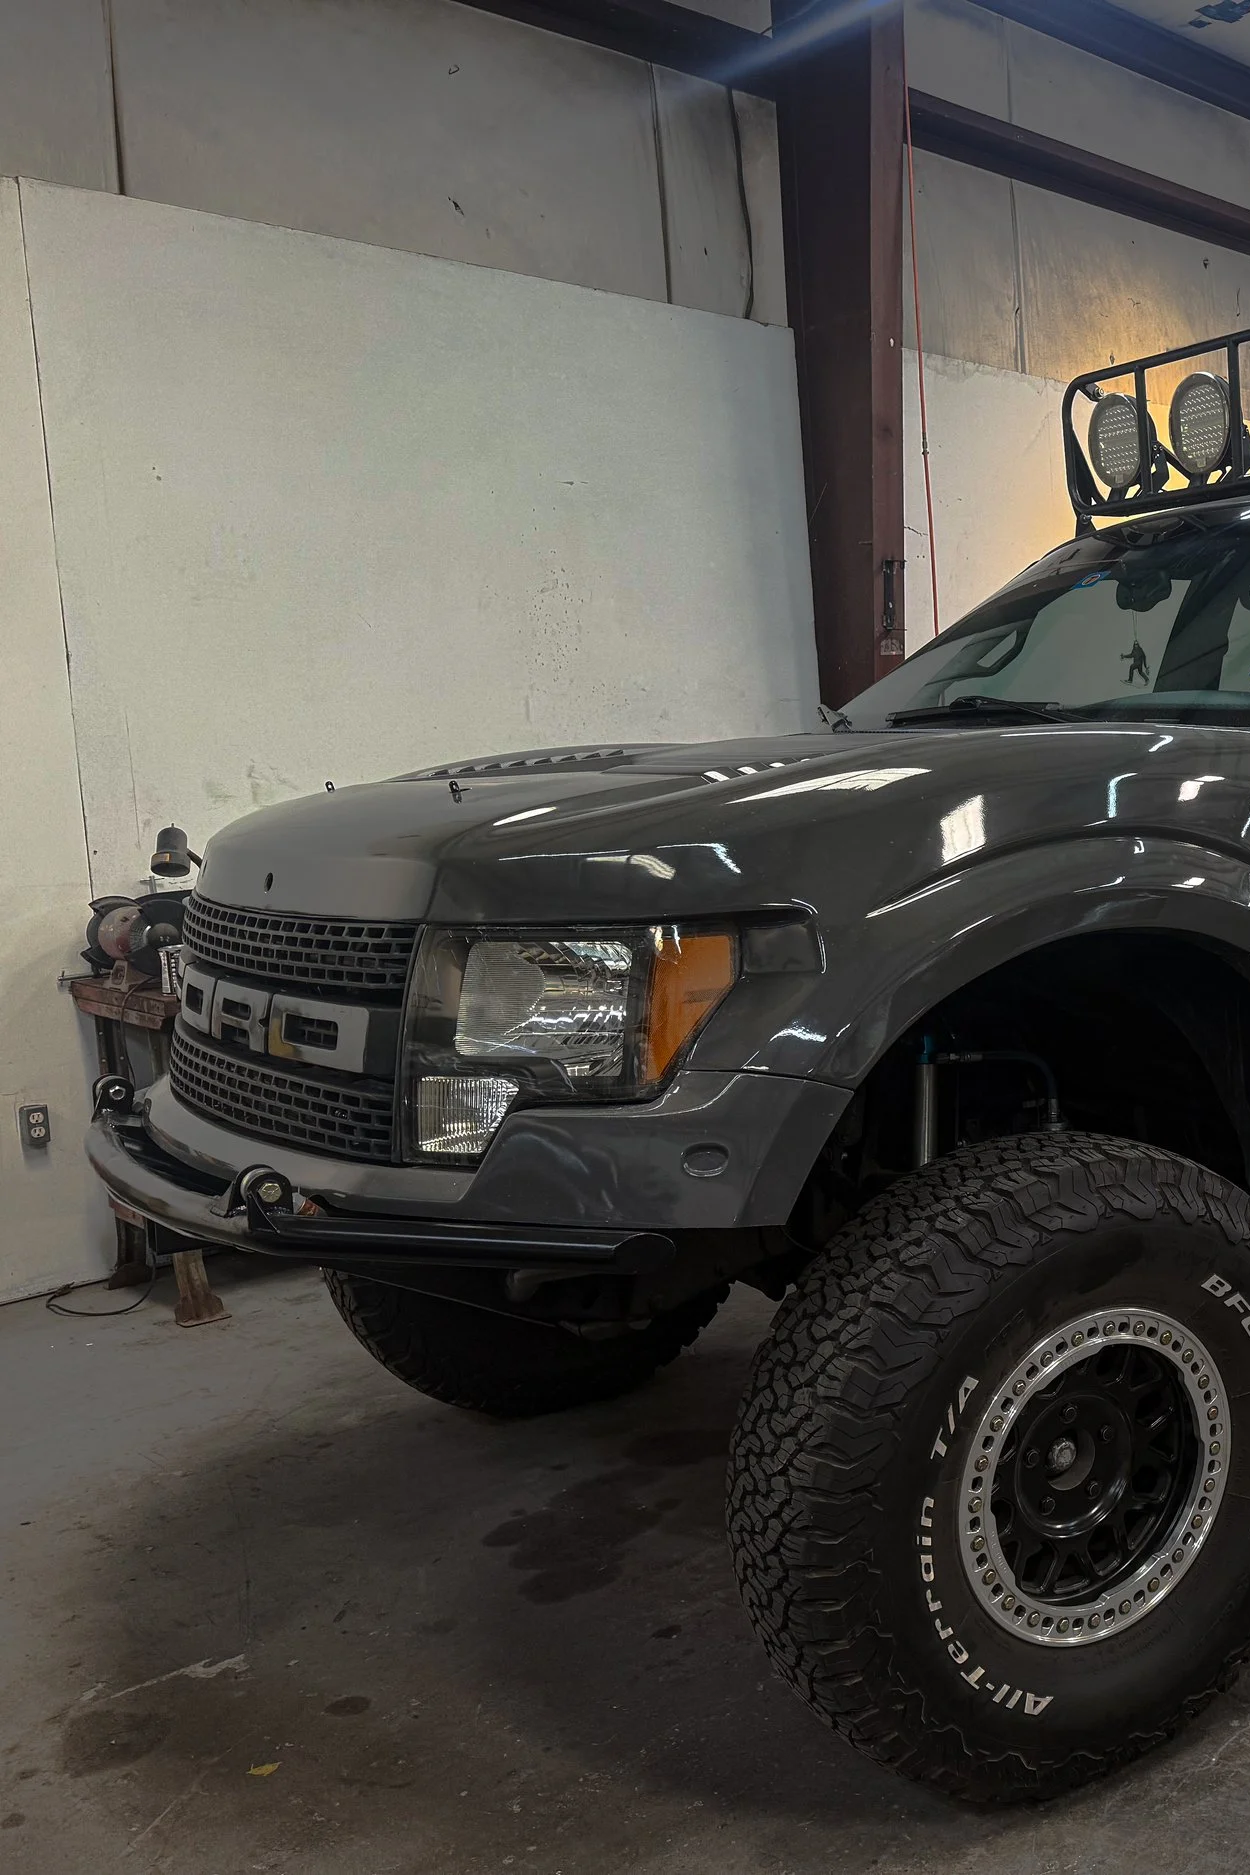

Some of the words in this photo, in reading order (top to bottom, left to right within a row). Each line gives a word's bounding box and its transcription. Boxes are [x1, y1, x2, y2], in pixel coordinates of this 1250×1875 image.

[177, 956, 370, 1073] ORD
[929, 1374, 979, 1460] T/A
[916, 1496, 1054, 1716] All-Terrain
